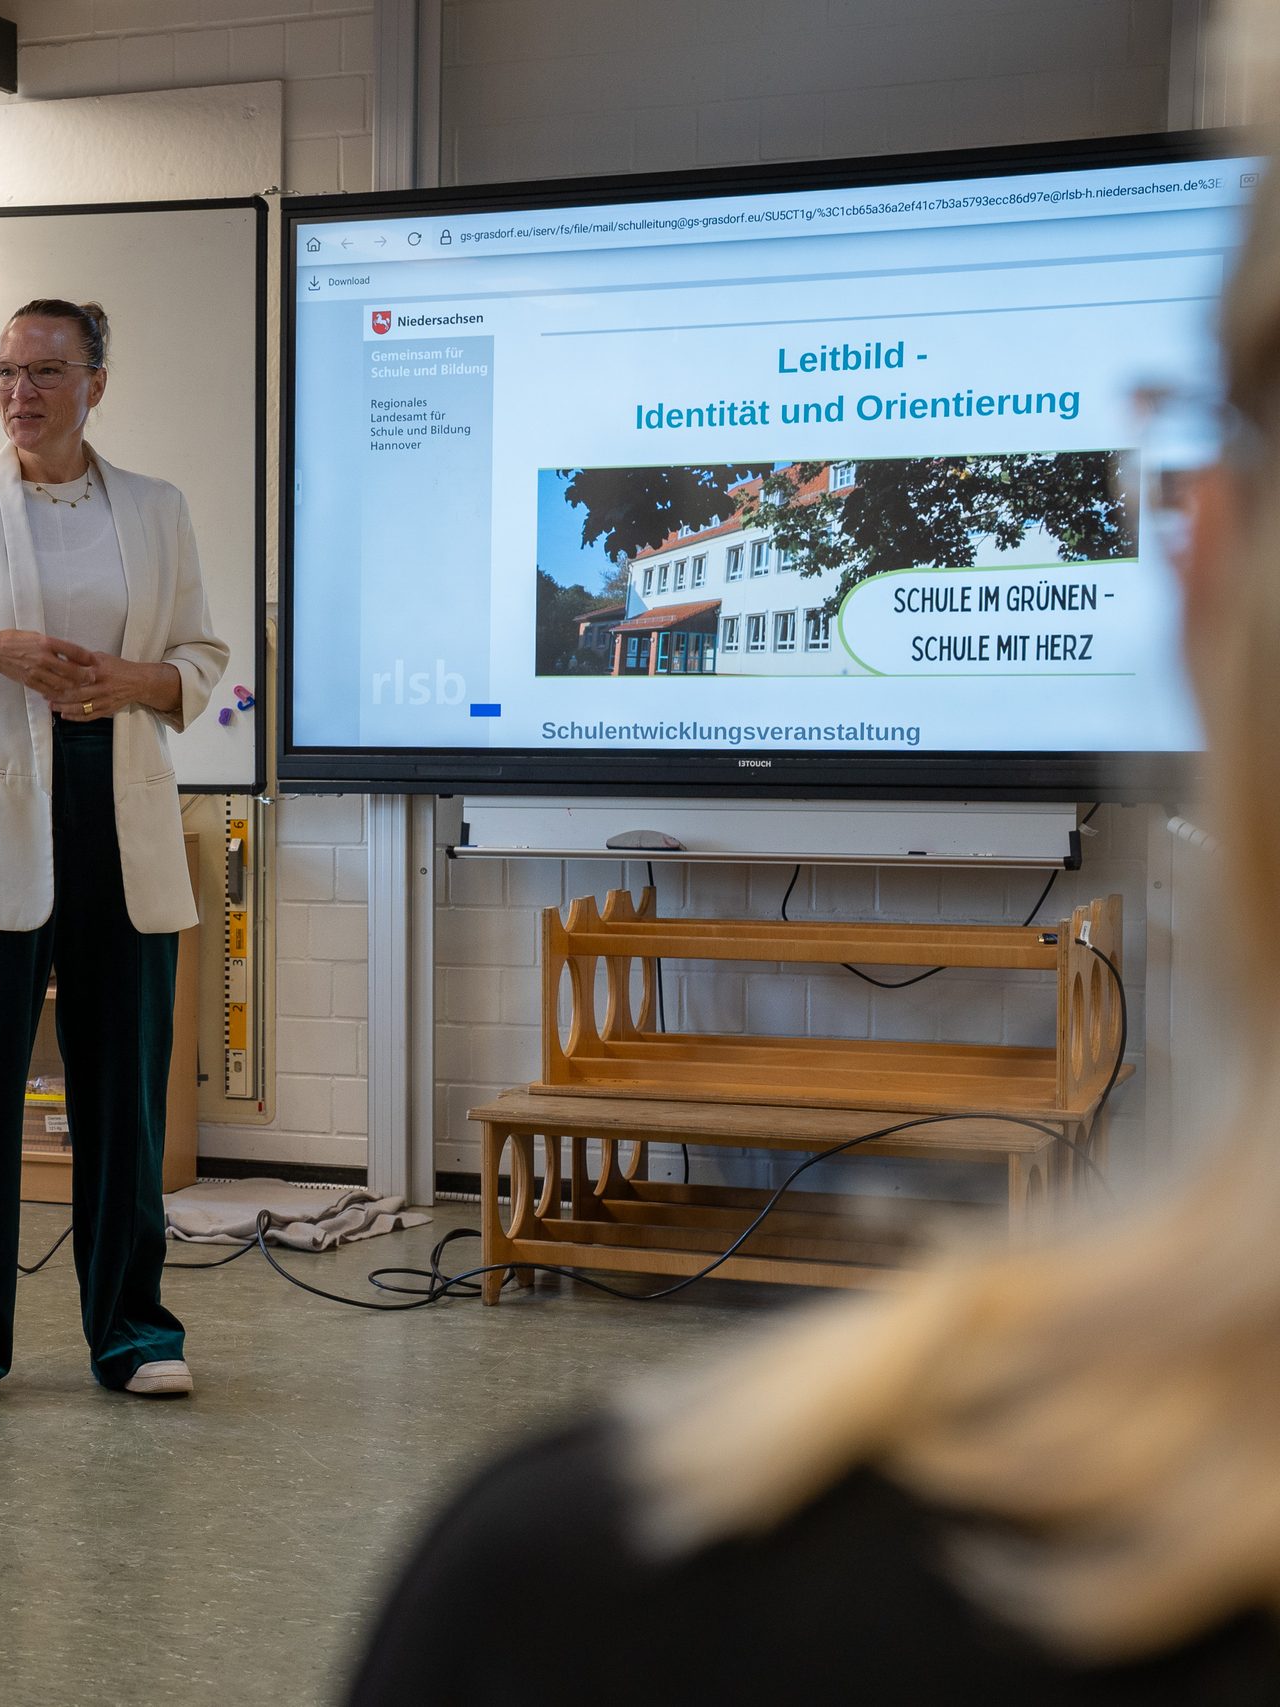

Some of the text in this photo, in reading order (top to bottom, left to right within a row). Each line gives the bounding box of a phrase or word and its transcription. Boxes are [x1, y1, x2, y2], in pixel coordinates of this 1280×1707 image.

[328, 276, 370, 286] Download
[397, 313, 484, 327] Niedersachsen
[371, 347, 464, 362] Gemeinsam für
[778, 341, 905, 374] Leitbild
[371, 363, 488, 378] Schule und Bildung
[370, 398, 428, 410] Regionales
[635, 390, 1080, 430] Identität und Orientierung
[370, 410, 446, 423] Landesamt für
[370, 424, 471, 437] Schule und Bildung
[370, 441, 421, 451] Hannover
[893, 586, 972, 613] SCHULE
[978, 585, 1000, 612] IM
[1006, 580, 1097, 612] GRÜNEN
[911, 634, 1094, 661] SCHULE MIT HERZ
[372, 659, 466, 705] rlsb
[541, 721, 921, 746] Schulentwicklungsveranstaltung
[233, 913, 243, 921] 4
[232, 1004, 243, 1012] 2
